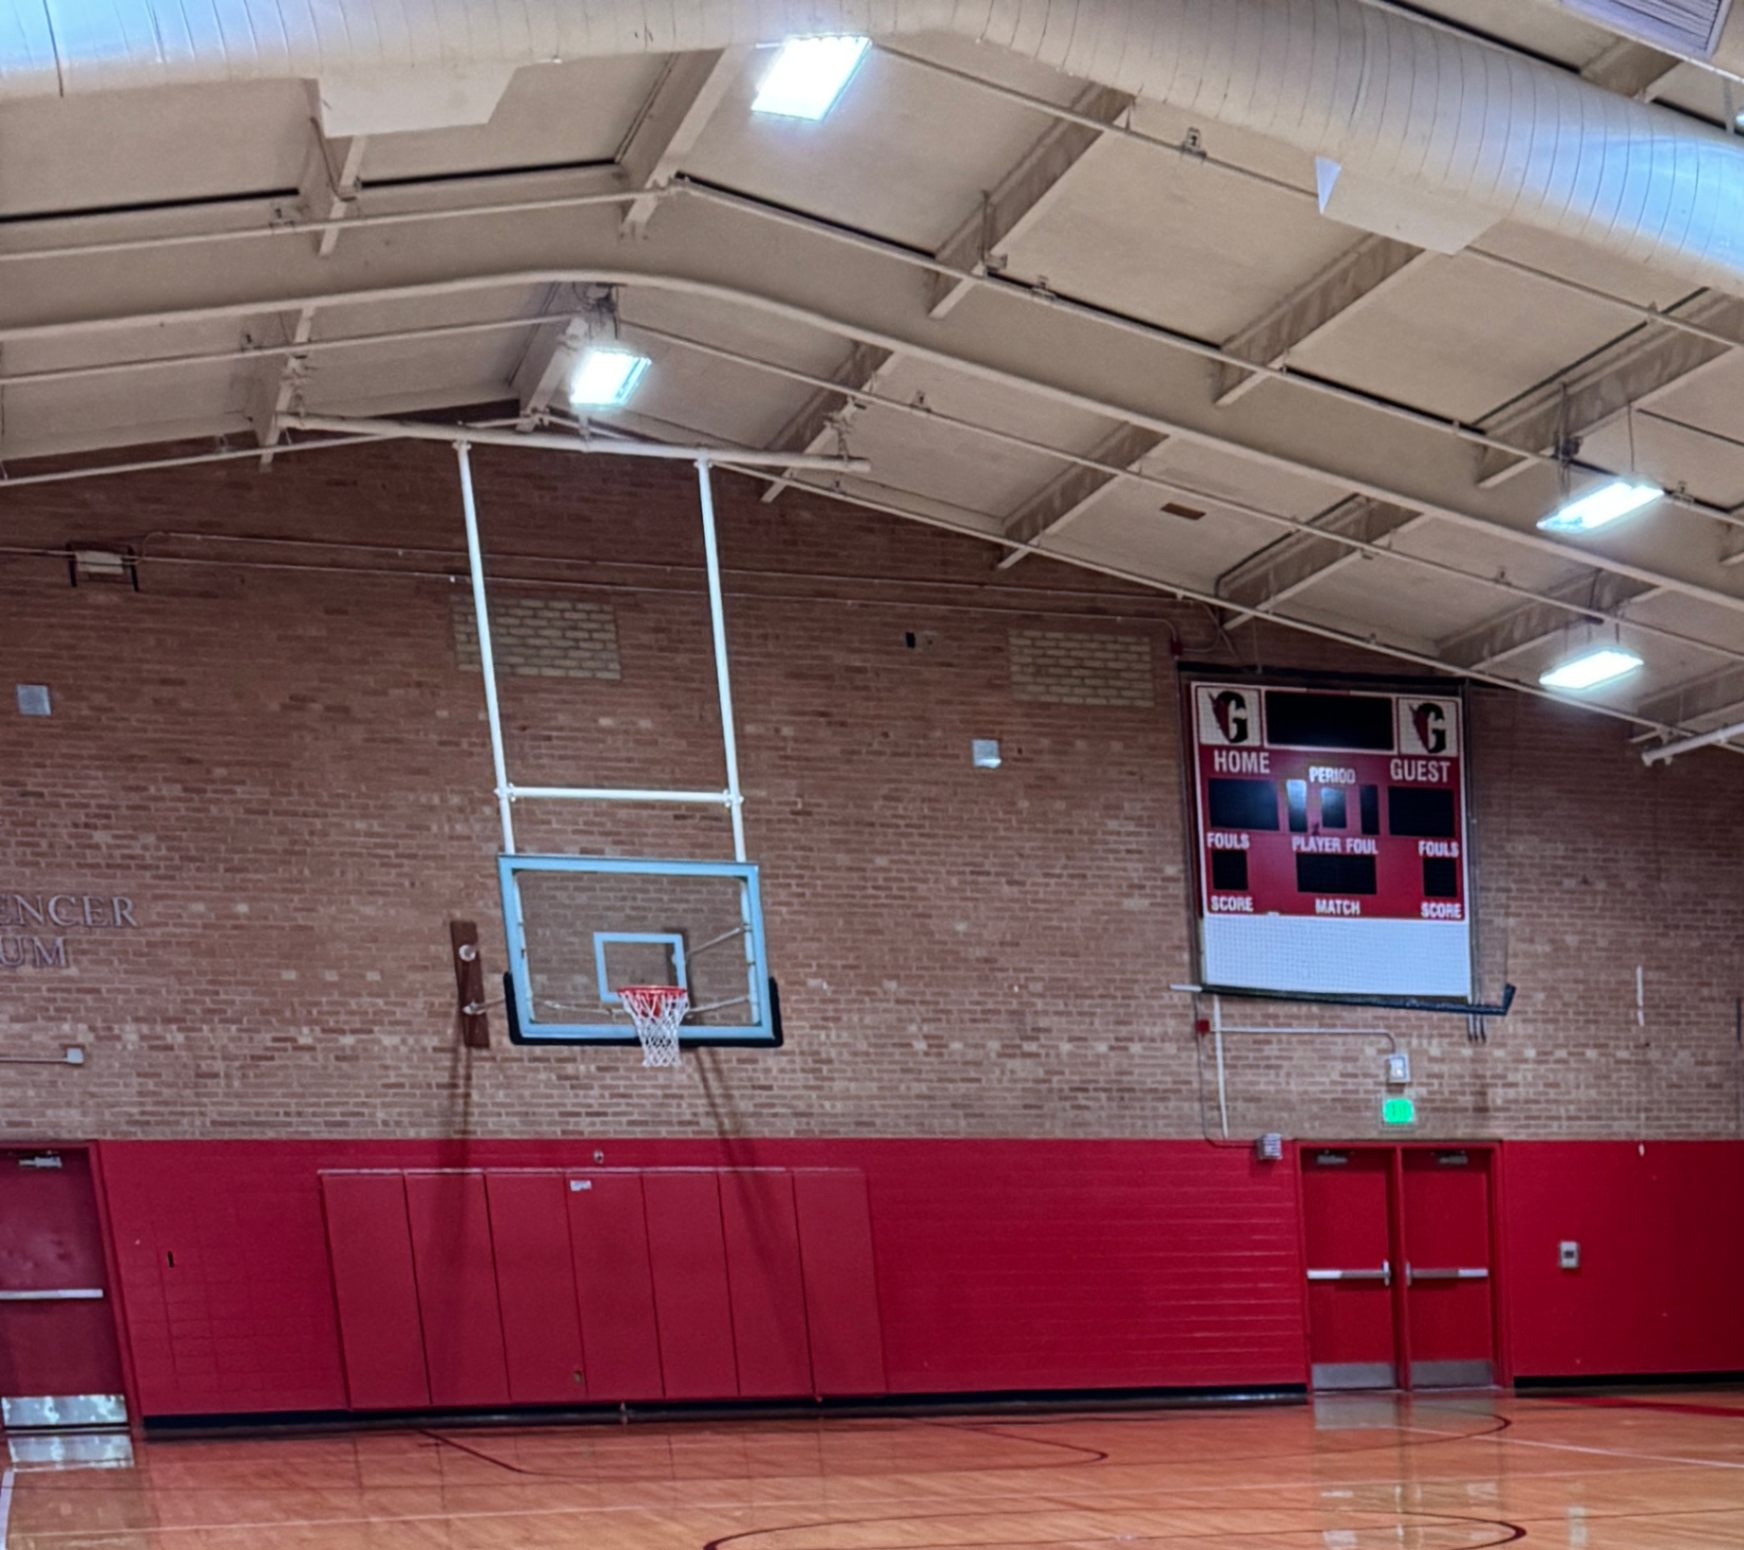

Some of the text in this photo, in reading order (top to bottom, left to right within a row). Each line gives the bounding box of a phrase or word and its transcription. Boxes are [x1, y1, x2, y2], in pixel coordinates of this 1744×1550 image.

[1208, 690, 1249, 744] G
[1408, 702, 1446, 753] G
[1213, 750, 1270, 774] HOME
[1390, 758, 1451, 783] GUEST
[1309, 766, 1356, 784] PERIOD
[1207, 833, 1249, 849] FOULS
[1292, 837, 1378, 855] PLAYER FOUL
[1418, 841, 1459, 858] FOULS
[1210, 895, 1254, 912] SCORE
[1315, 899, 1360, 915] MATCH
[1420, 902, 1462, 918] SCORE
